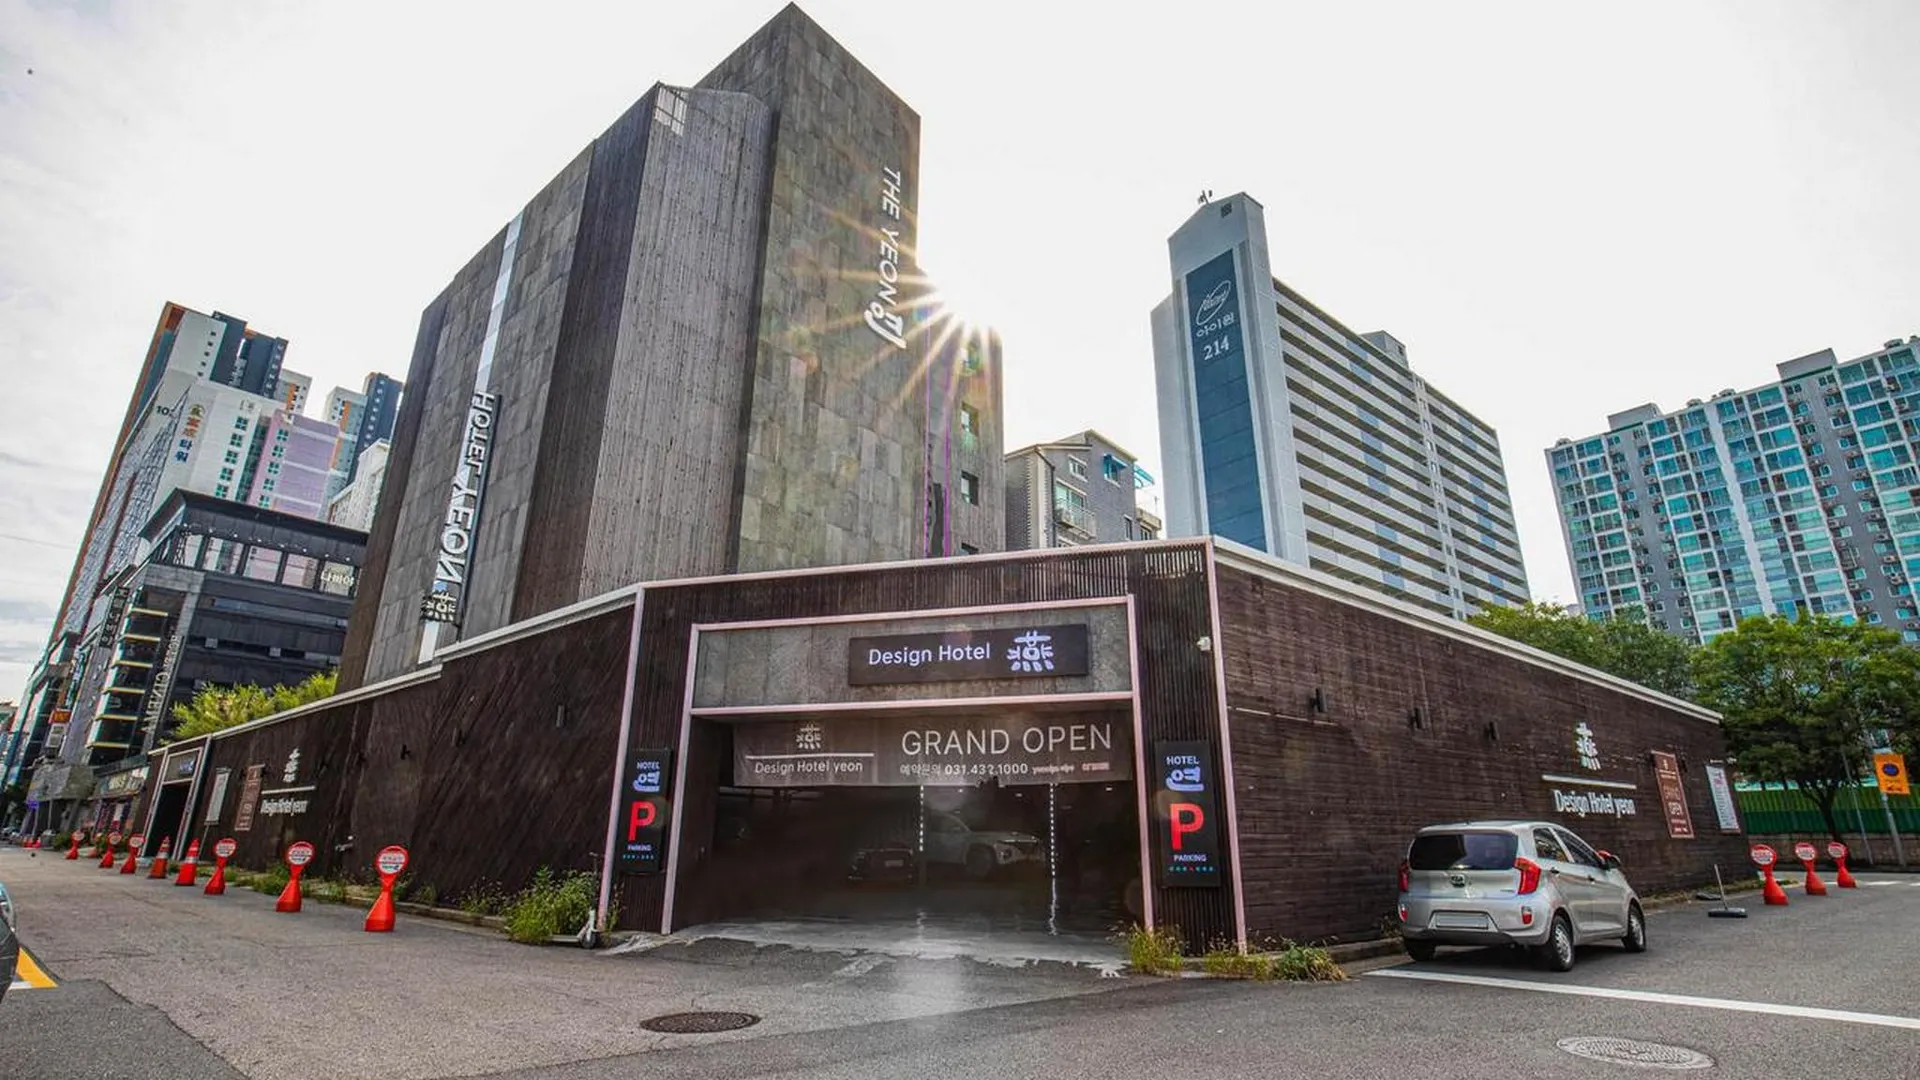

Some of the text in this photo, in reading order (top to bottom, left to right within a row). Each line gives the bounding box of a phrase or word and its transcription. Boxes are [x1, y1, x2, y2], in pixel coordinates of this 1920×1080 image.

[882, 166, 901, 221] THE
[878, 227, 900, 306] YEON
[1204, 335, 1230, 360] 214
[466, 391, 496, 476] HOTEL
[437, 475, 478, 585] YEON
[868, 648, 932, 667] Design
[938, 643, 991, 662] Hotel
[901, 723, 1111, 755] GRAND OPEN
[636, 761, 660, 770] HOTEL
[755, 760, 863, 775] Design Hotel yeon
[900, 763, 941, 777] 예약문의
[944, 762, 1028, 776] 031.432.1000
[1166, 755, 1200, 765] HOTEL
[1552, 789, 1636, 818] Design Hotel yeon
[627, 801, 657, 841] P
[1170, 803, 1204, 850] P
[1173, 854, 1207, 862] PARKING
